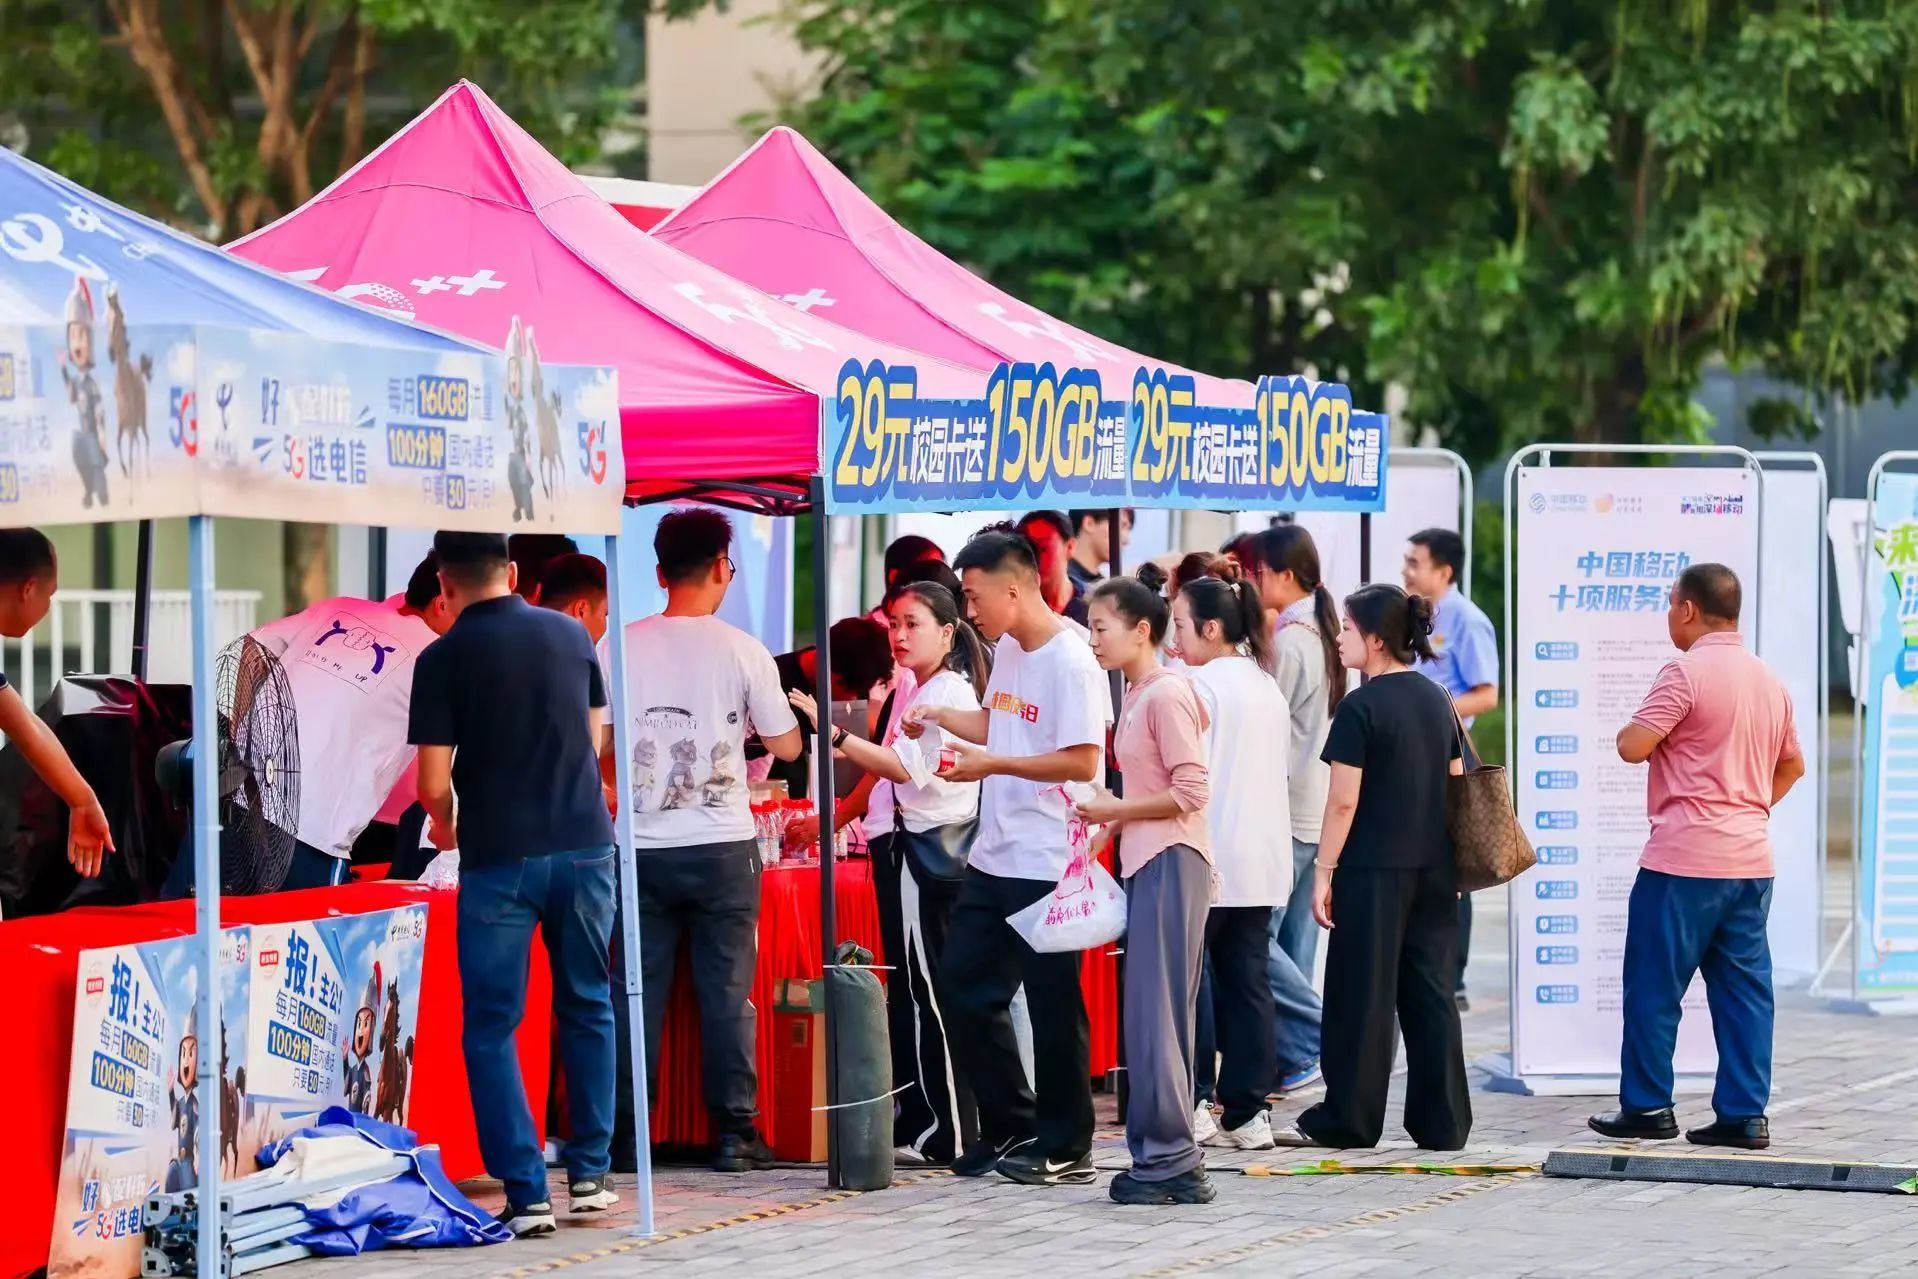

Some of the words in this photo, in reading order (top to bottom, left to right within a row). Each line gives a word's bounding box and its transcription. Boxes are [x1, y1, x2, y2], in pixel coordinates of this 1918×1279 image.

[283, 433, 367, 484] 5G选电信
[577, 420, 606, 486] 5G
[836, 374, 1126, 488] 29元校园卡送150GB流量
[1132, 382, 1381, 488] 29元校园卡送150GB流量
[1549, 584, 1675, 612] 十项服务
